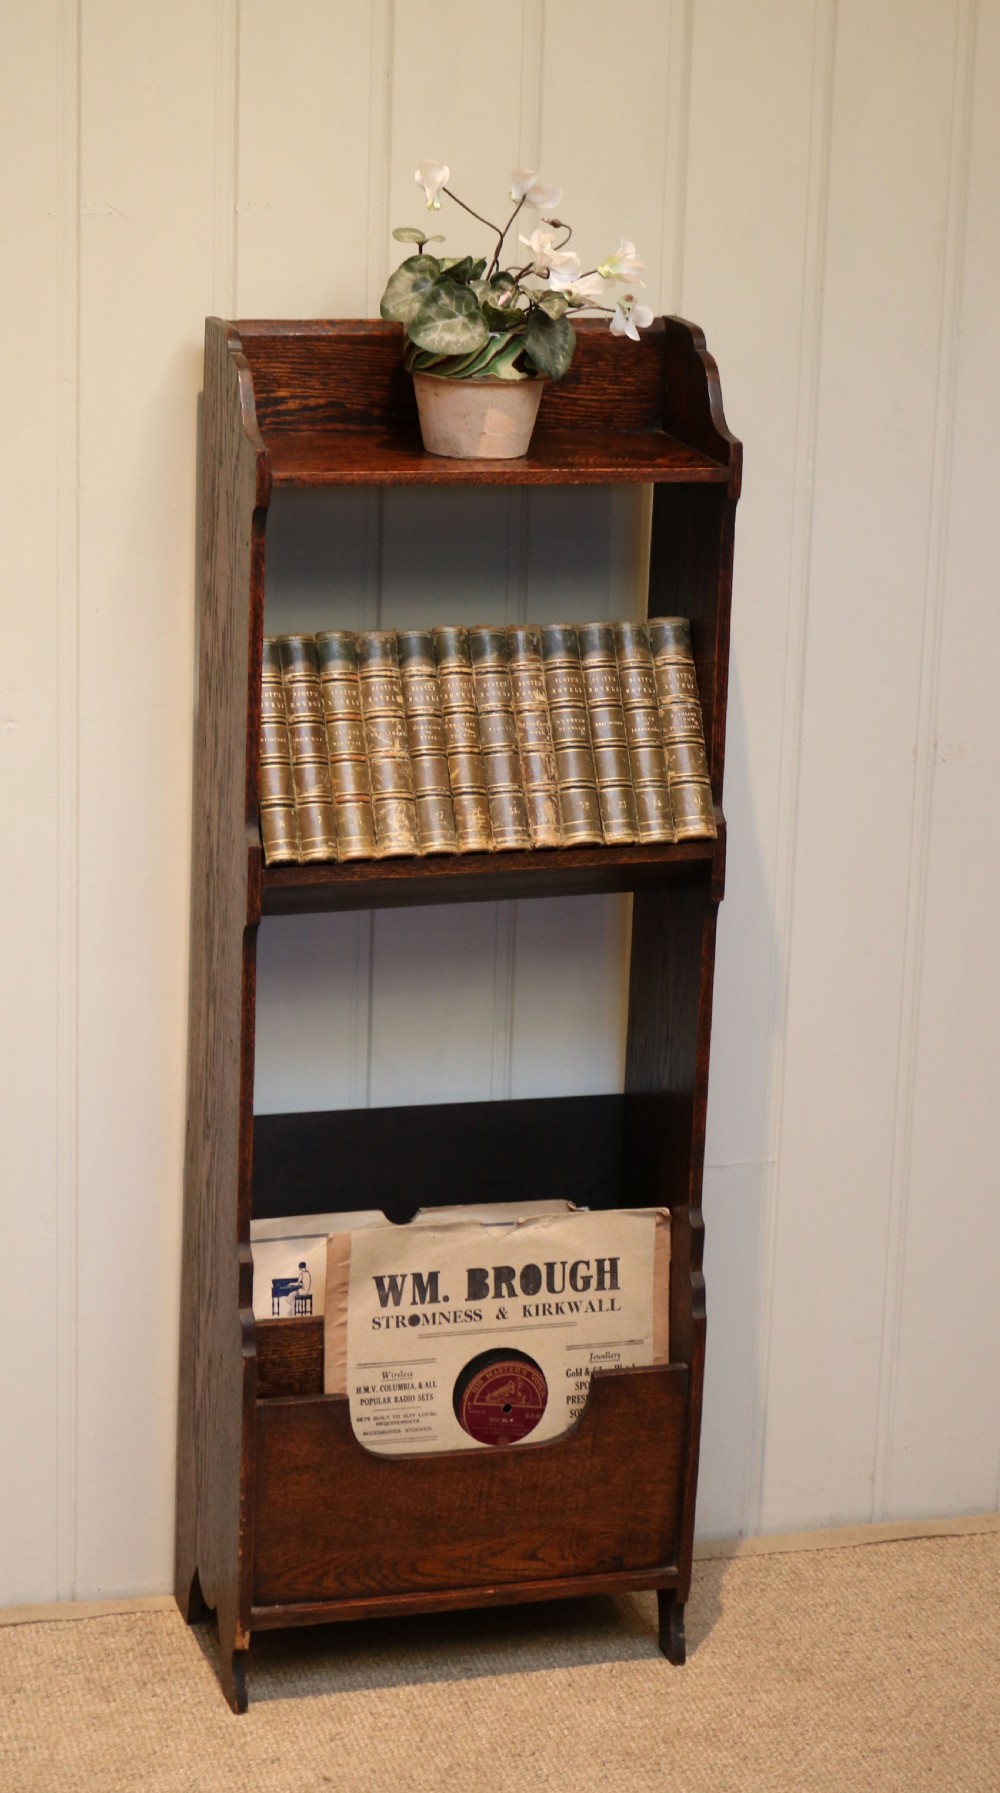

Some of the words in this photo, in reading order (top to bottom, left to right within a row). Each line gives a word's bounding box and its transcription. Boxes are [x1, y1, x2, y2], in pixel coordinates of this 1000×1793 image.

[372, 1271, 450, 1308] WM.
[464, 1257, 621, 1302] BROUGH
[372, 1309, 483, 1330] STROMNESS
[495, 1307, 508, 1320] &
[522, 1298, 621, 1318] KIRKWALL
[589, 1352, 621, 1361] Jewellery
[381, 1371, 413, 1380] Wireless
[565, 1367, 583, 1378] Gold
[584, 1366, 591, 1377] &
[379, 1382, 417, 1393] COLUMBIA,
[418, 1381, 423, 1390] &
[425, 1380, 437, 1389] ALL
[471, 1381, 485, 1394] HIS
[486, 1366, 528, 1380] MASTER'S
[360, 1396, 391, 1406] POPULAR
[394, 1395, 415, 1404] RADIO
[417, 1393, 434, 1402] SETS
